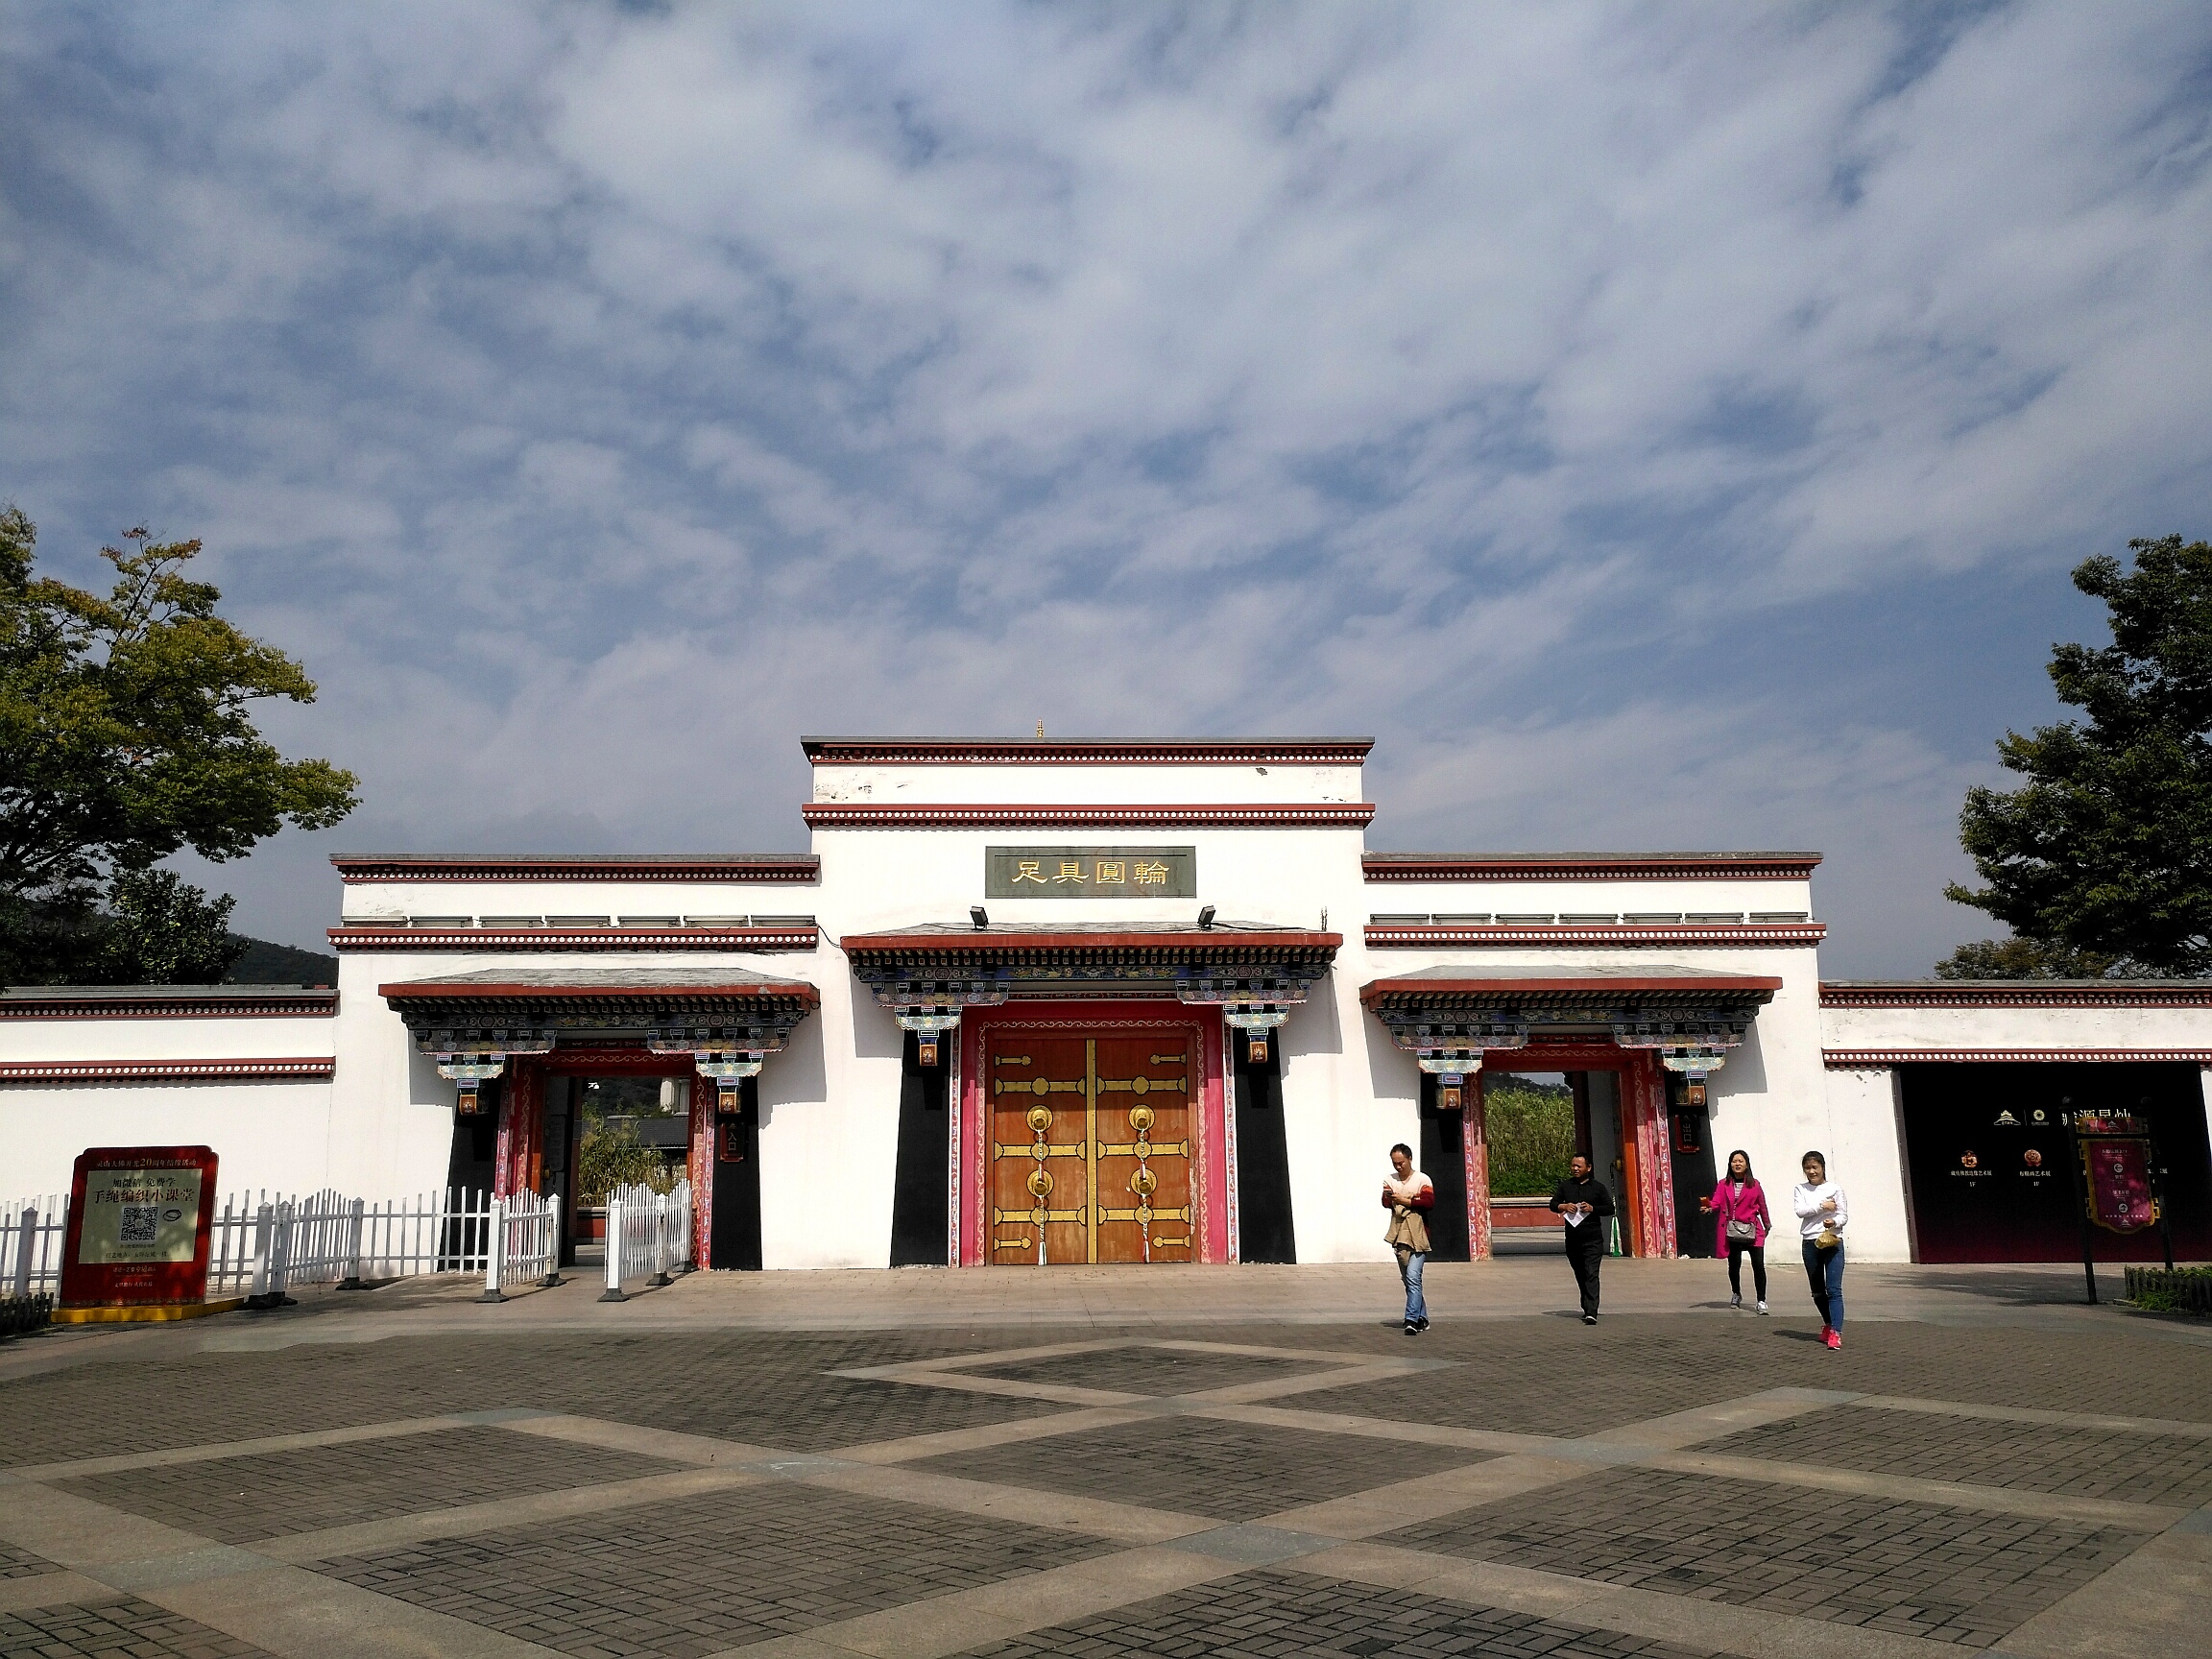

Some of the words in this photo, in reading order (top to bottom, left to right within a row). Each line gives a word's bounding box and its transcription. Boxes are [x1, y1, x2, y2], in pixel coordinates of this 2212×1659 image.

[1682, 1122, 1693, 1142] 出口
[727, 1132, 737, 1151] 入口
[112, 1178, 141, 1188] 加微信
[146, 1177, 176, 1187] 免费学
[94, 1189, 195, 1204] 手绳编织小课堂
